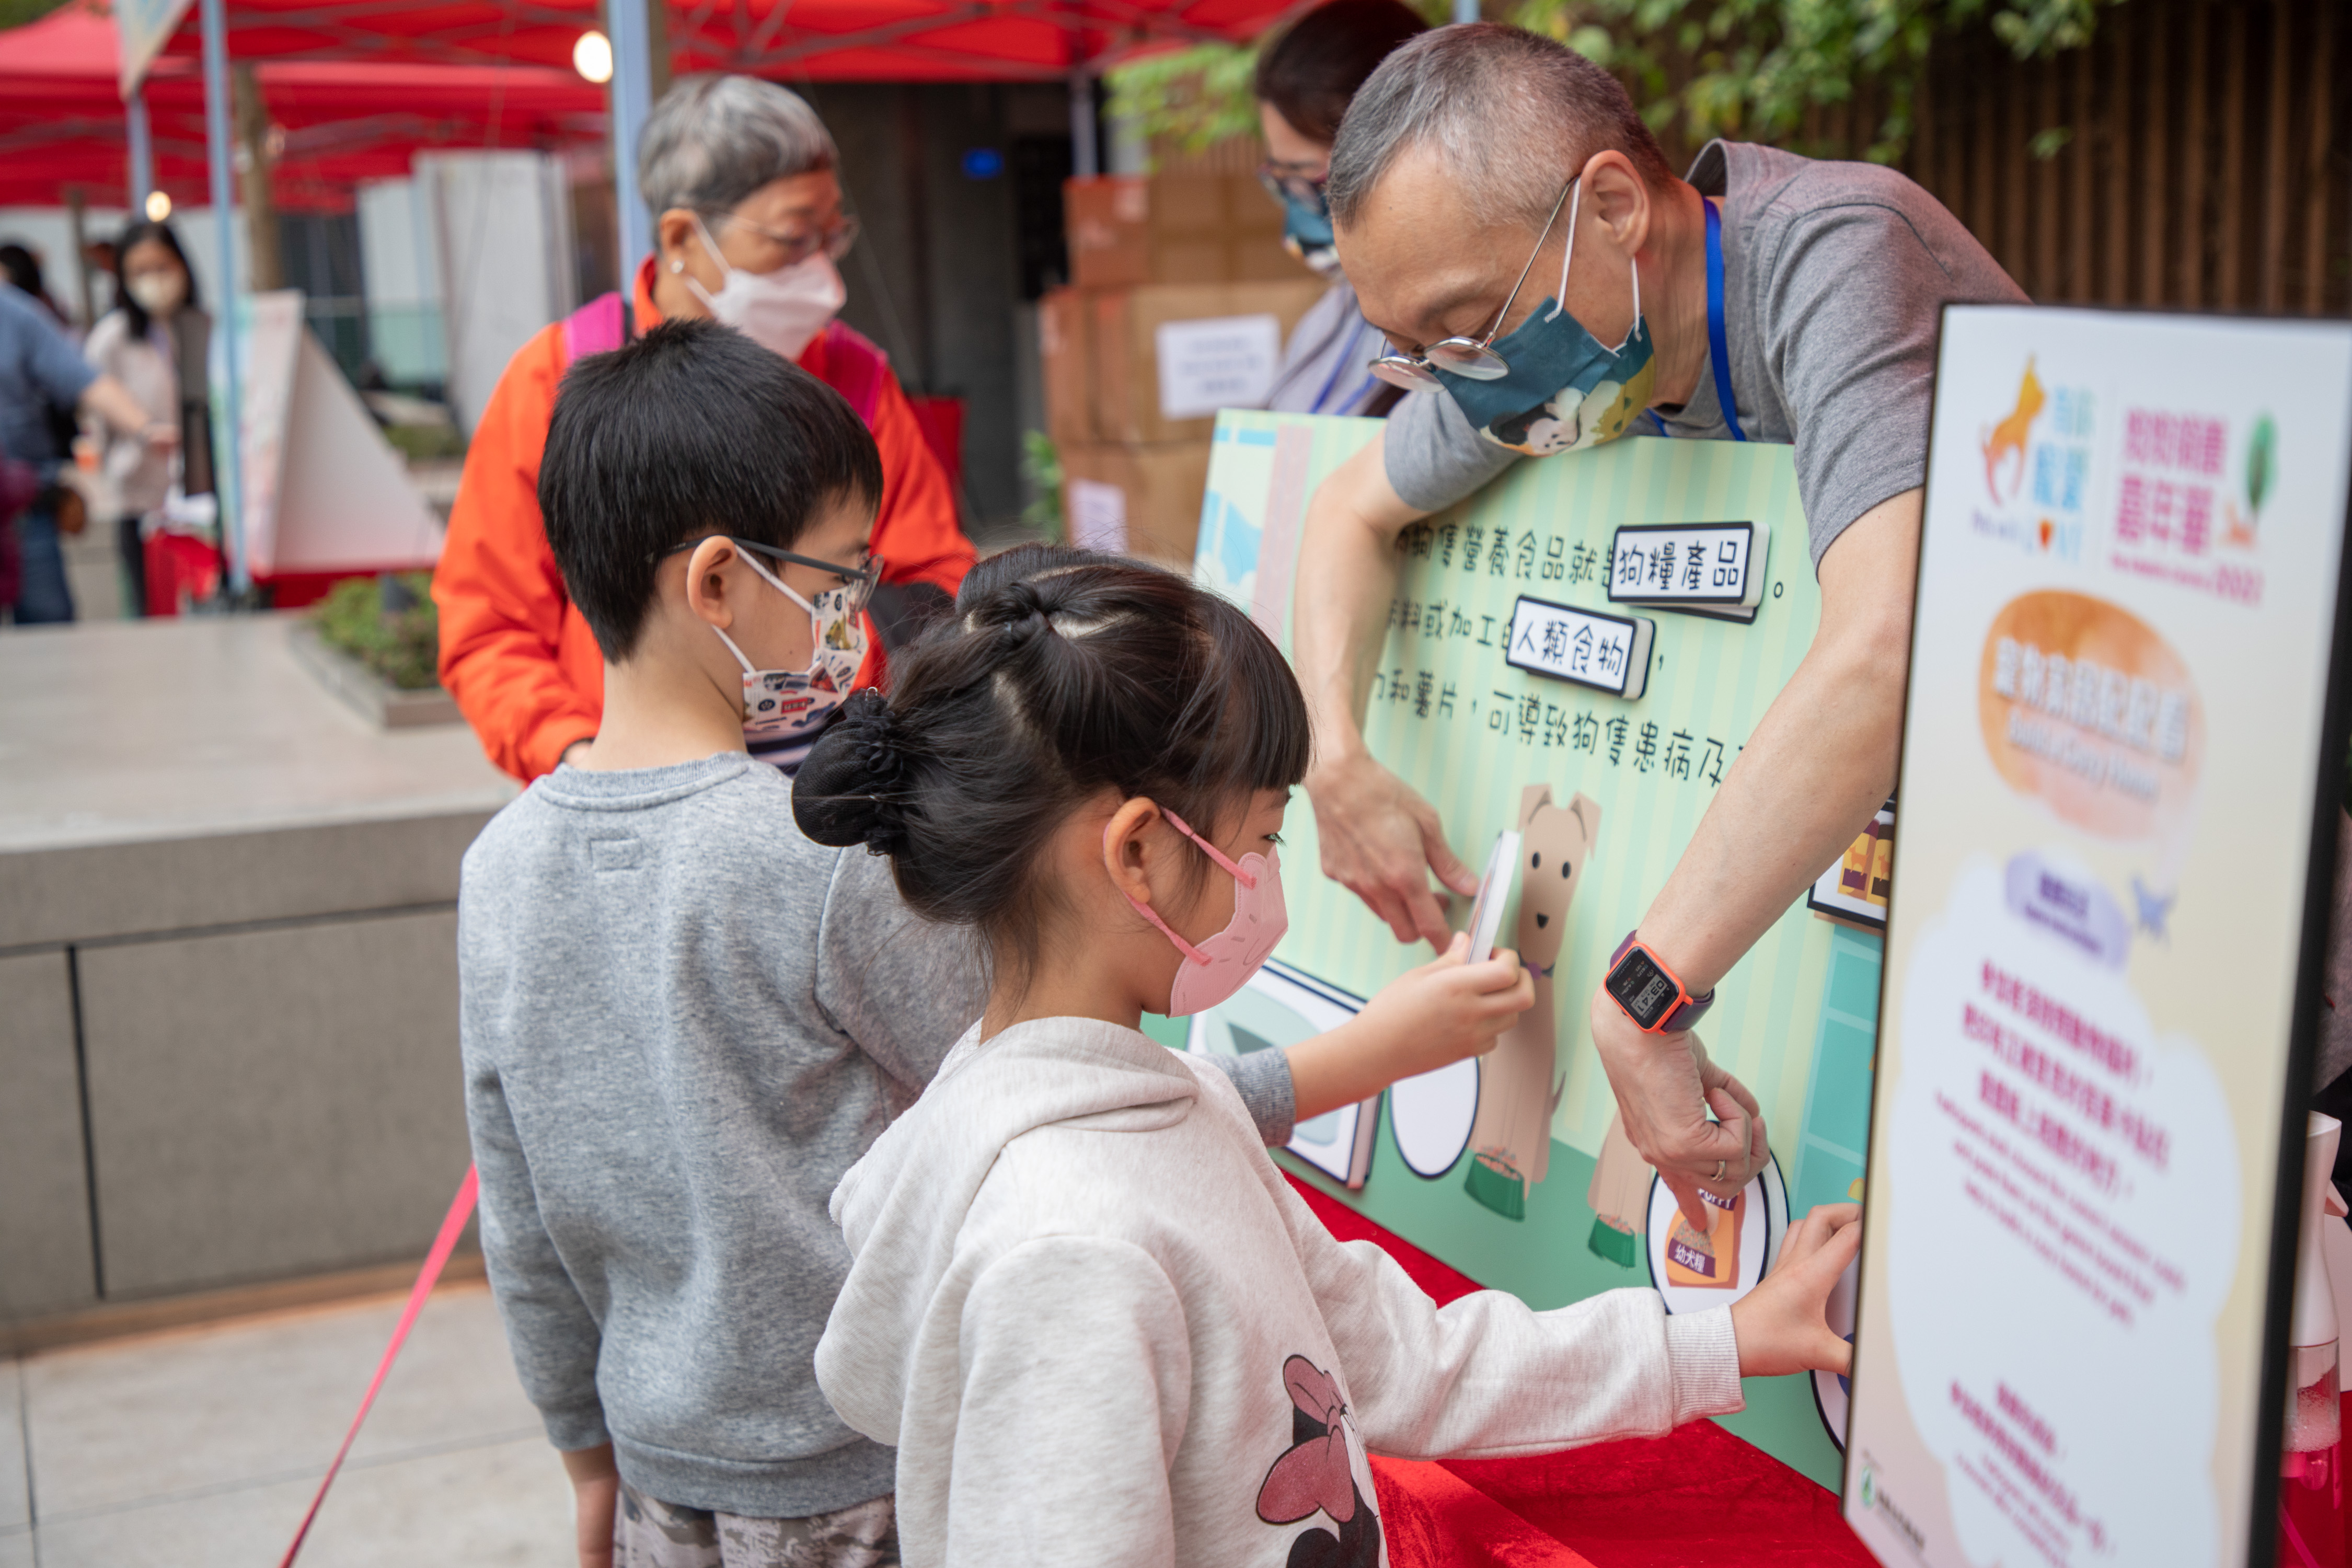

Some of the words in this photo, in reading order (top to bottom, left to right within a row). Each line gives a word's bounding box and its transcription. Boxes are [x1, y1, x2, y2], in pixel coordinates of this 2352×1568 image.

[1619, 539, 1739, 591] 狗糧產品
[1517, 619, 1623, 676] 人類食物
[1637, 980, 1665, 1011] 03:41
[1675, 1243, 1705, 1274] 幼犬糧
